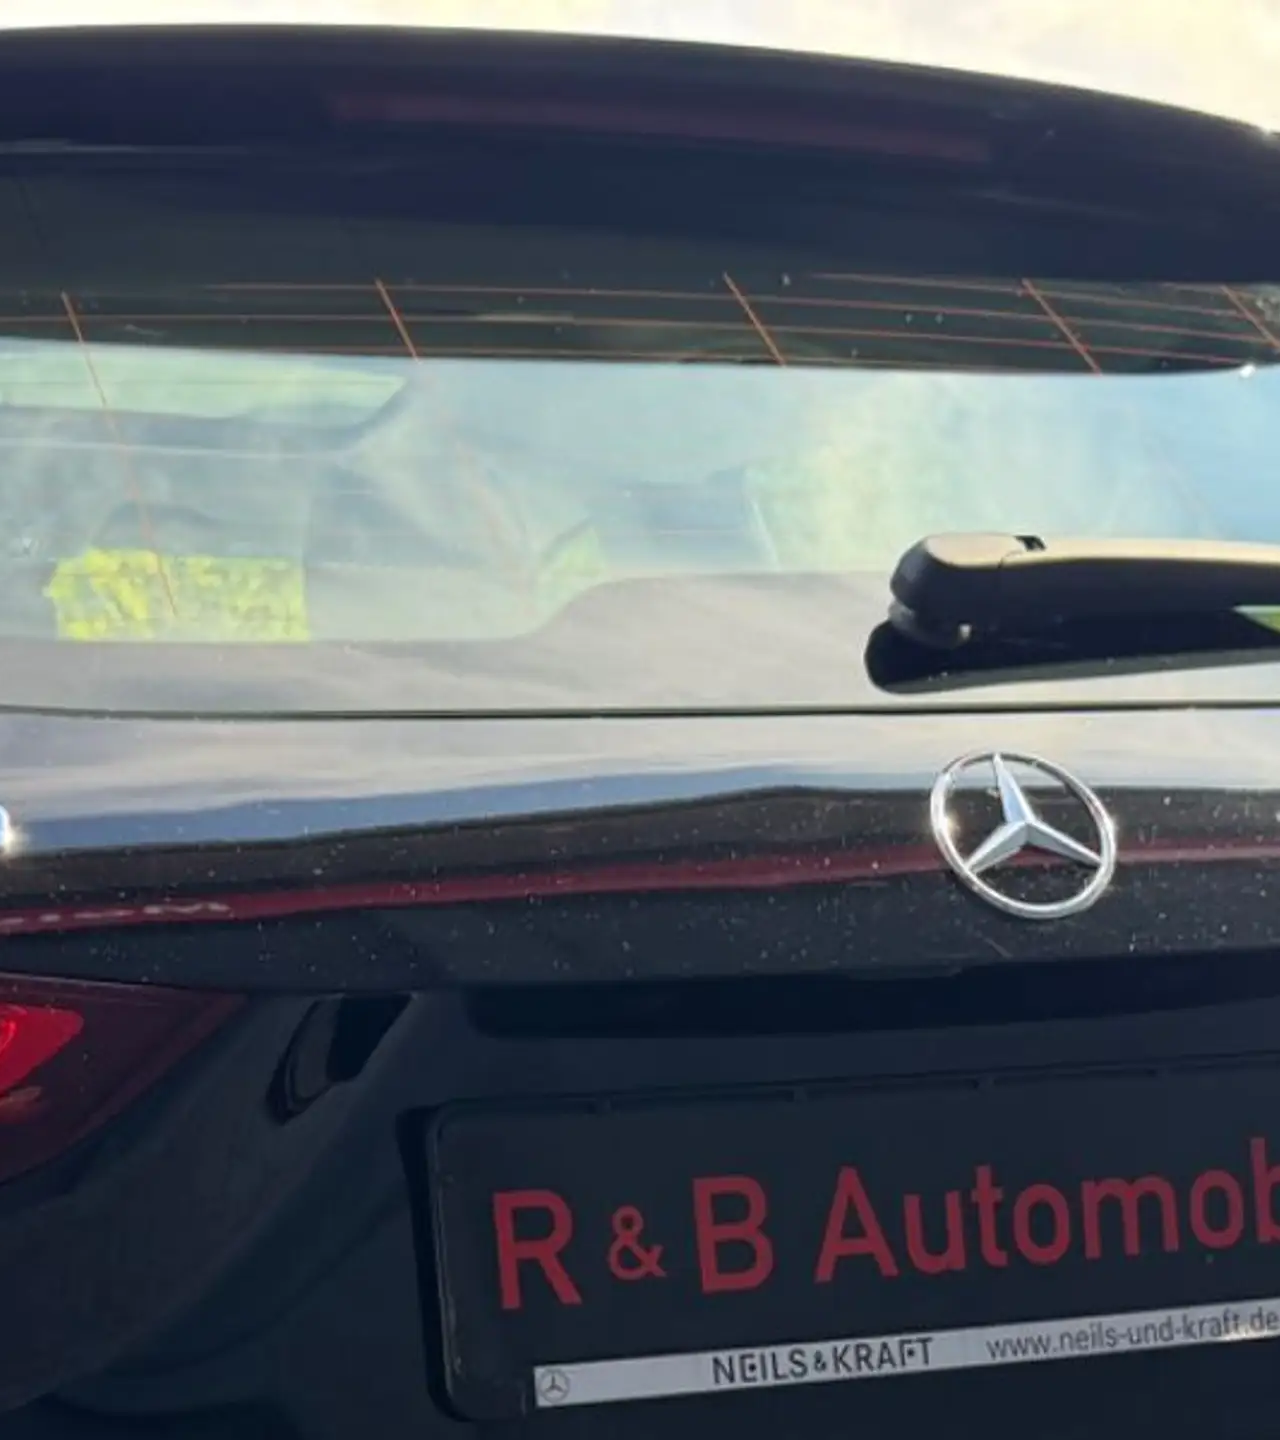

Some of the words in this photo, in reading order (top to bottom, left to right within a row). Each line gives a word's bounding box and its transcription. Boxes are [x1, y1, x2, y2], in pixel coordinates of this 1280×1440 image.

[494, 1190, 579, 1308] R
[609, 1205, 664, 1278] &
[694, 1177, 776, 1293] B
[985, 1305, 1280, 1361] www.neils-und-kraft.de
